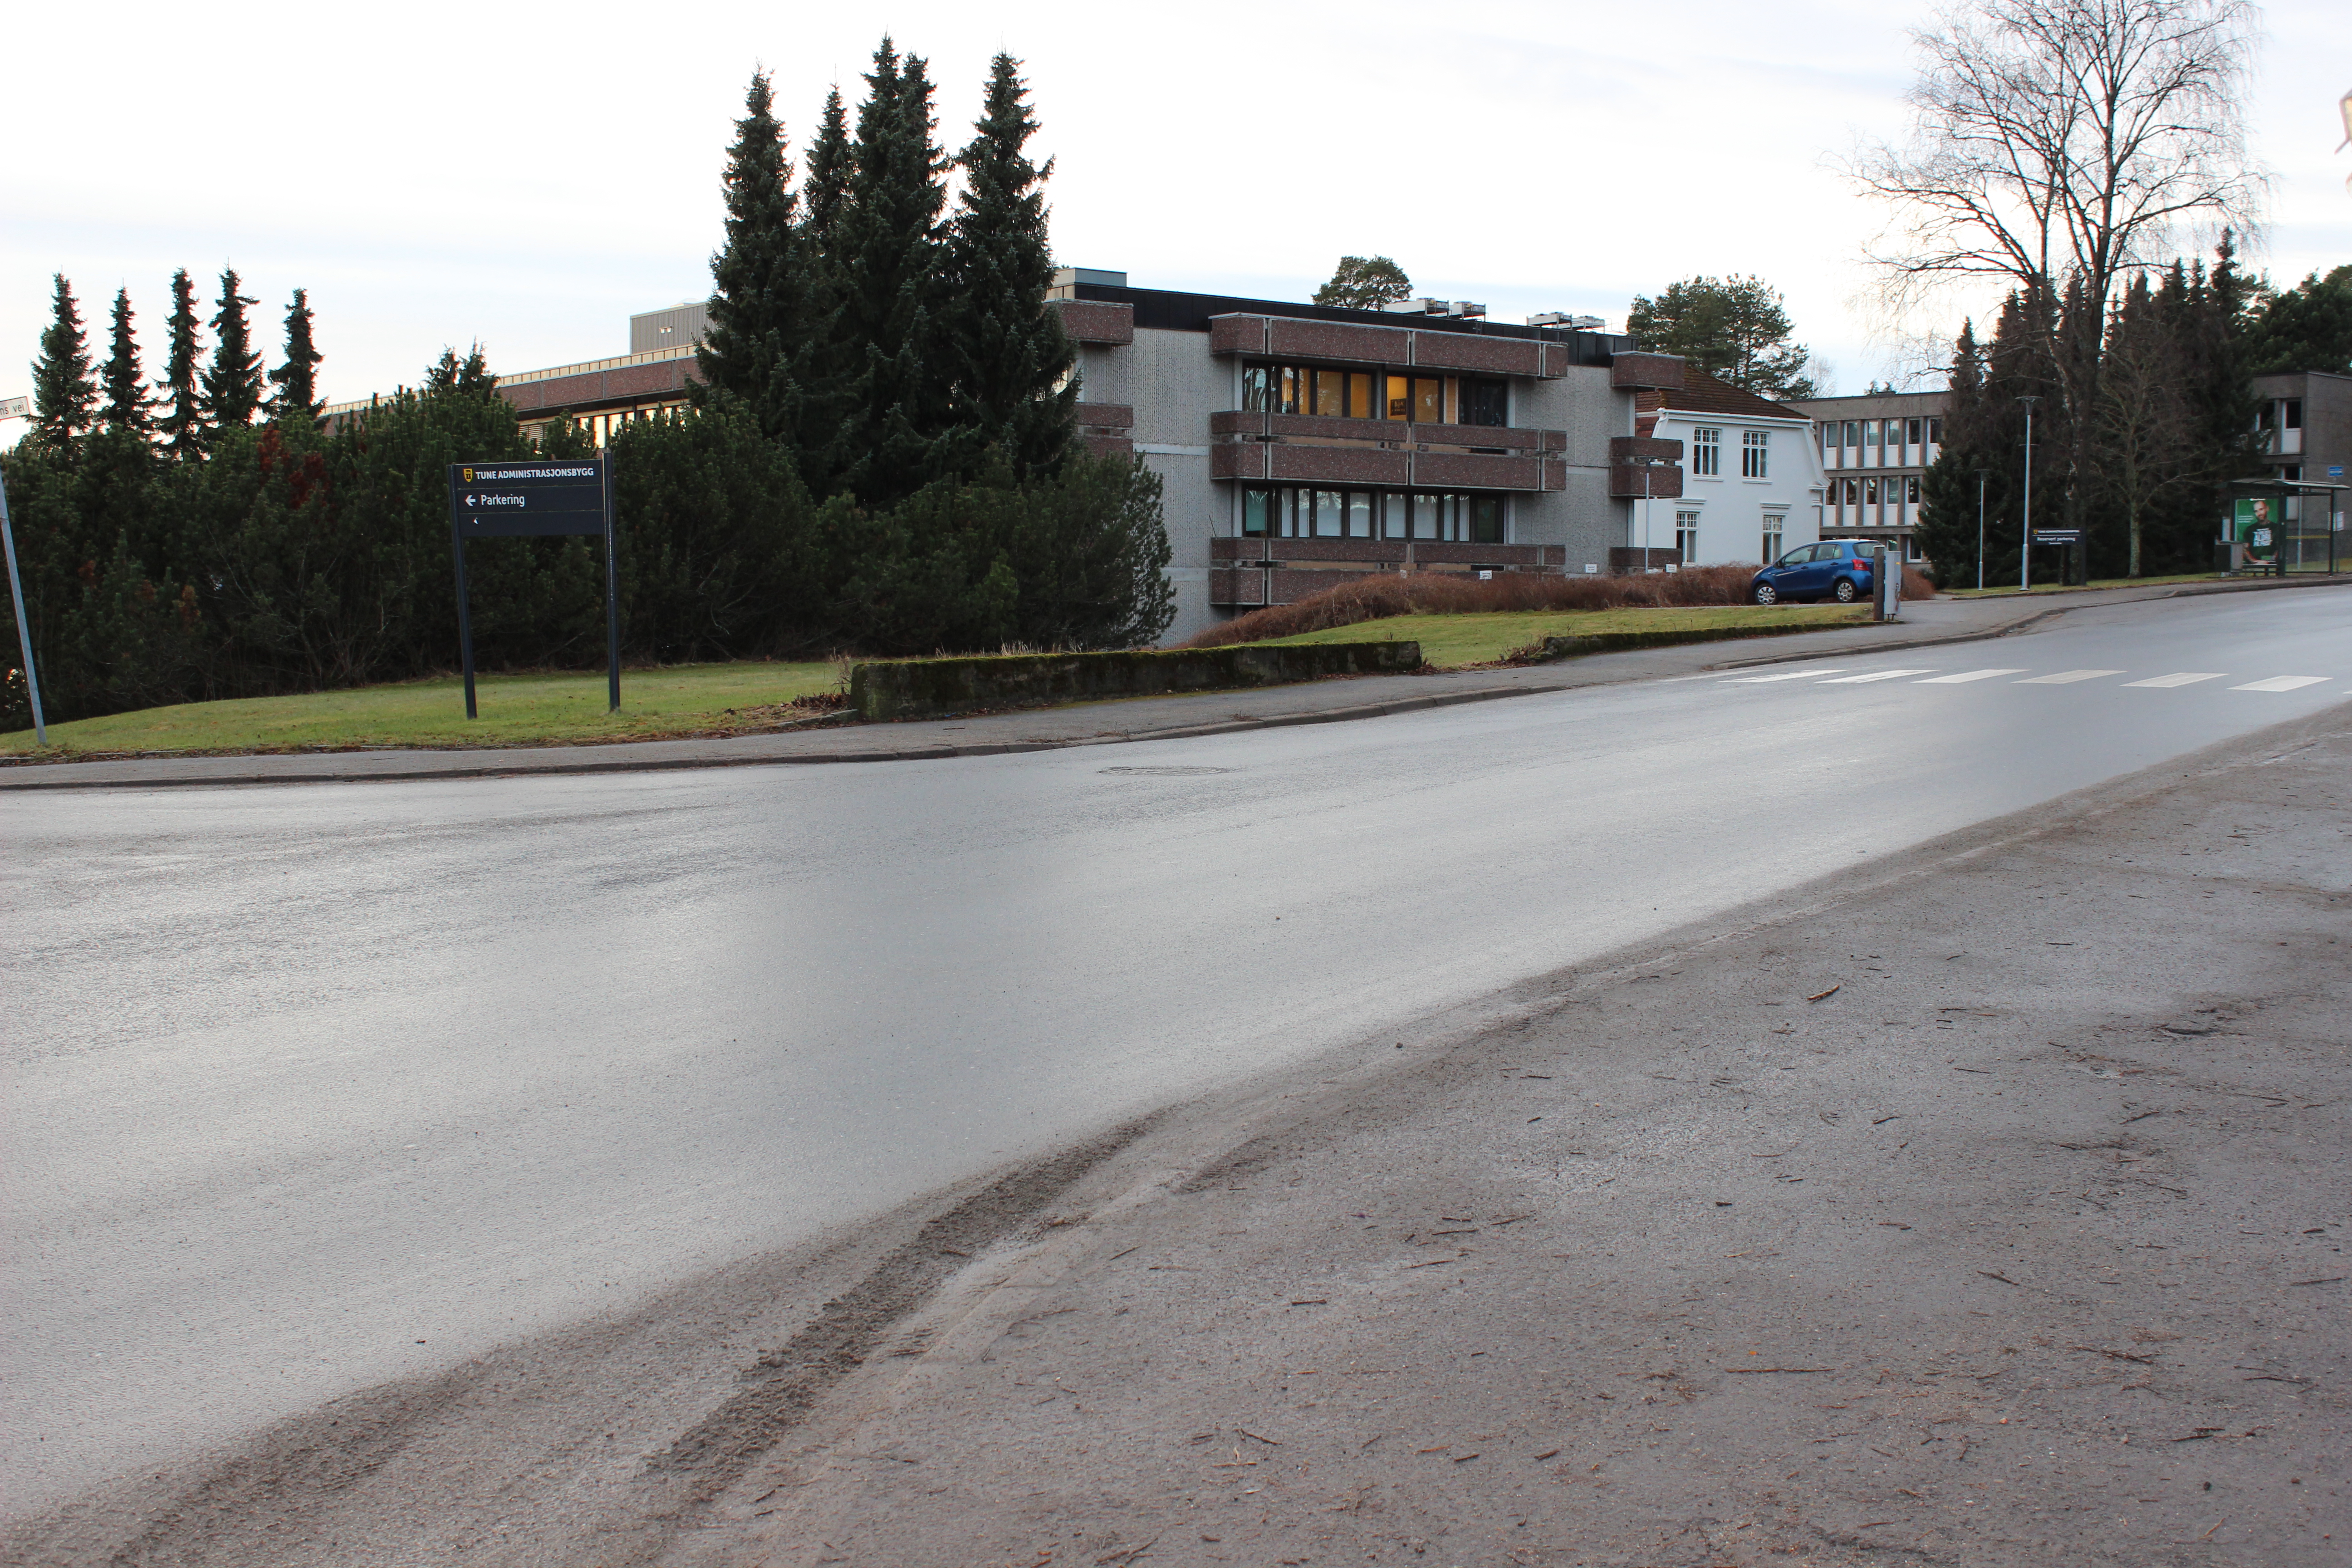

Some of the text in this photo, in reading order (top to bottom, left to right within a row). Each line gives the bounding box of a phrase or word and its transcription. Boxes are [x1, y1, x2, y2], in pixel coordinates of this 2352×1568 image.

[12, 402, 24, 412] vei
[475, 468, 594, 480] TUNE ADMINISTRASJONSBYGG
[480, 494, 525, 507] Parkering
